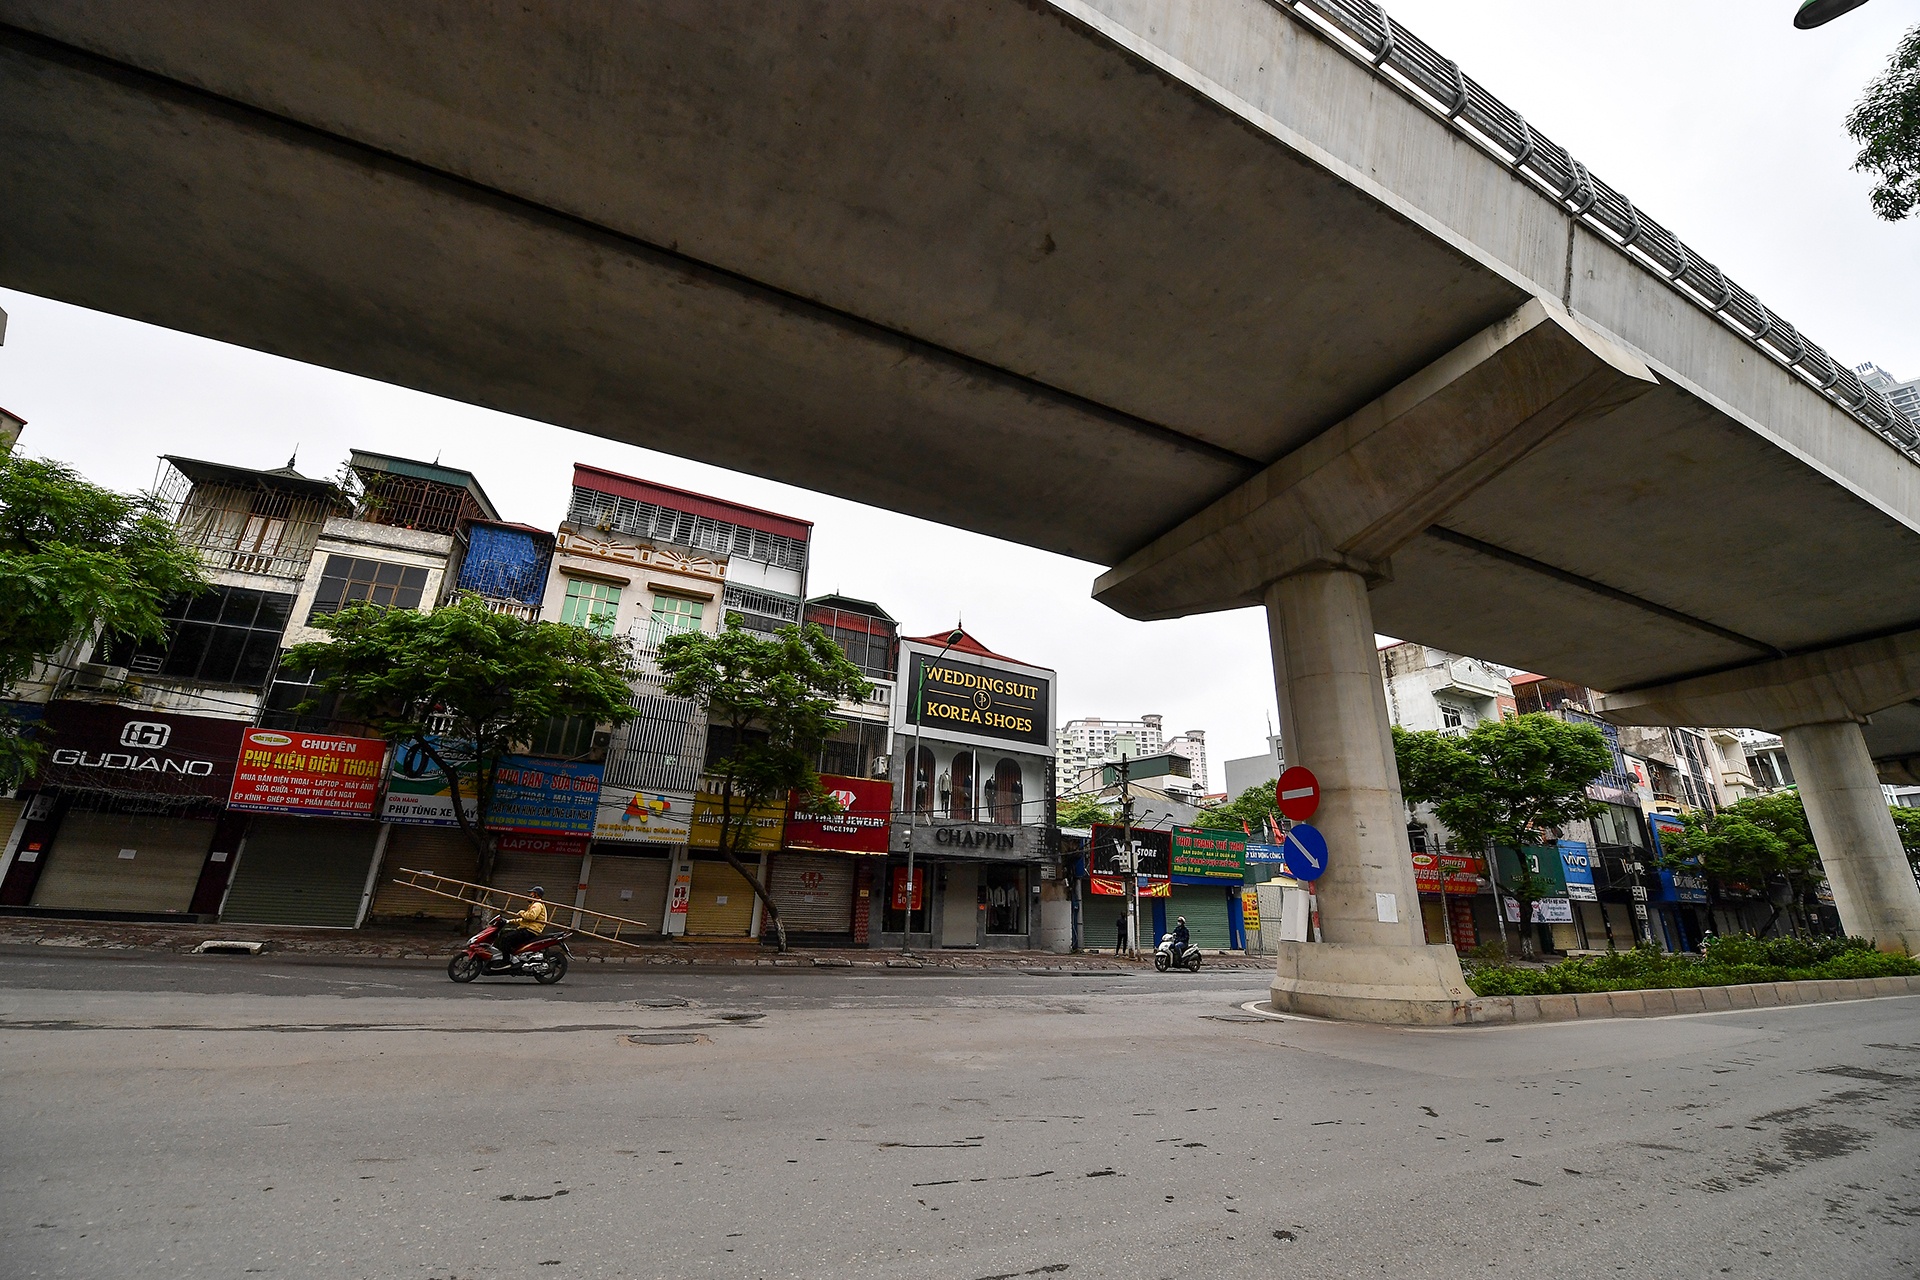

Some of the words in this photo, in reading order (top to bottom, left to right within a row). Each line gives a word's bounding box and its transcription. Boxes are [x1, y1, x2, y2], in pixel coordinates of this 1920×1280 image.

[926, 666, 1004, 694] WEDDING
[1005, 679, 1039, 701] SUIT
[926, 701, 982, 725] KOREA
[984, 711, 1033, 733] SHOES
[301, 738, 357, 753] CHUYÊN
[52, 749, 214, 777] GUDIANO
[243, 749, 272, 772] PHỤ
[273, 750, 306, 774] KIỆN
[308, 753, 340, 776] ĐIỆN
[342, 758, 380, 780] THOẠI
[388, 805, 409, 816] PHỤ
[412, 804, 437, 817] TÙNG
[439, 808, 453, 817] XE
[756, 818, 779, 828] CITY
[846, 816, 885, 827] JEWELRY
[502, 838, 551, 850] LAPTOP
[936, 828, 1016, 849] CHAPPIN
[1137, 848, 1158, 857] STORE
[898, 883, 918, 892] SAE
